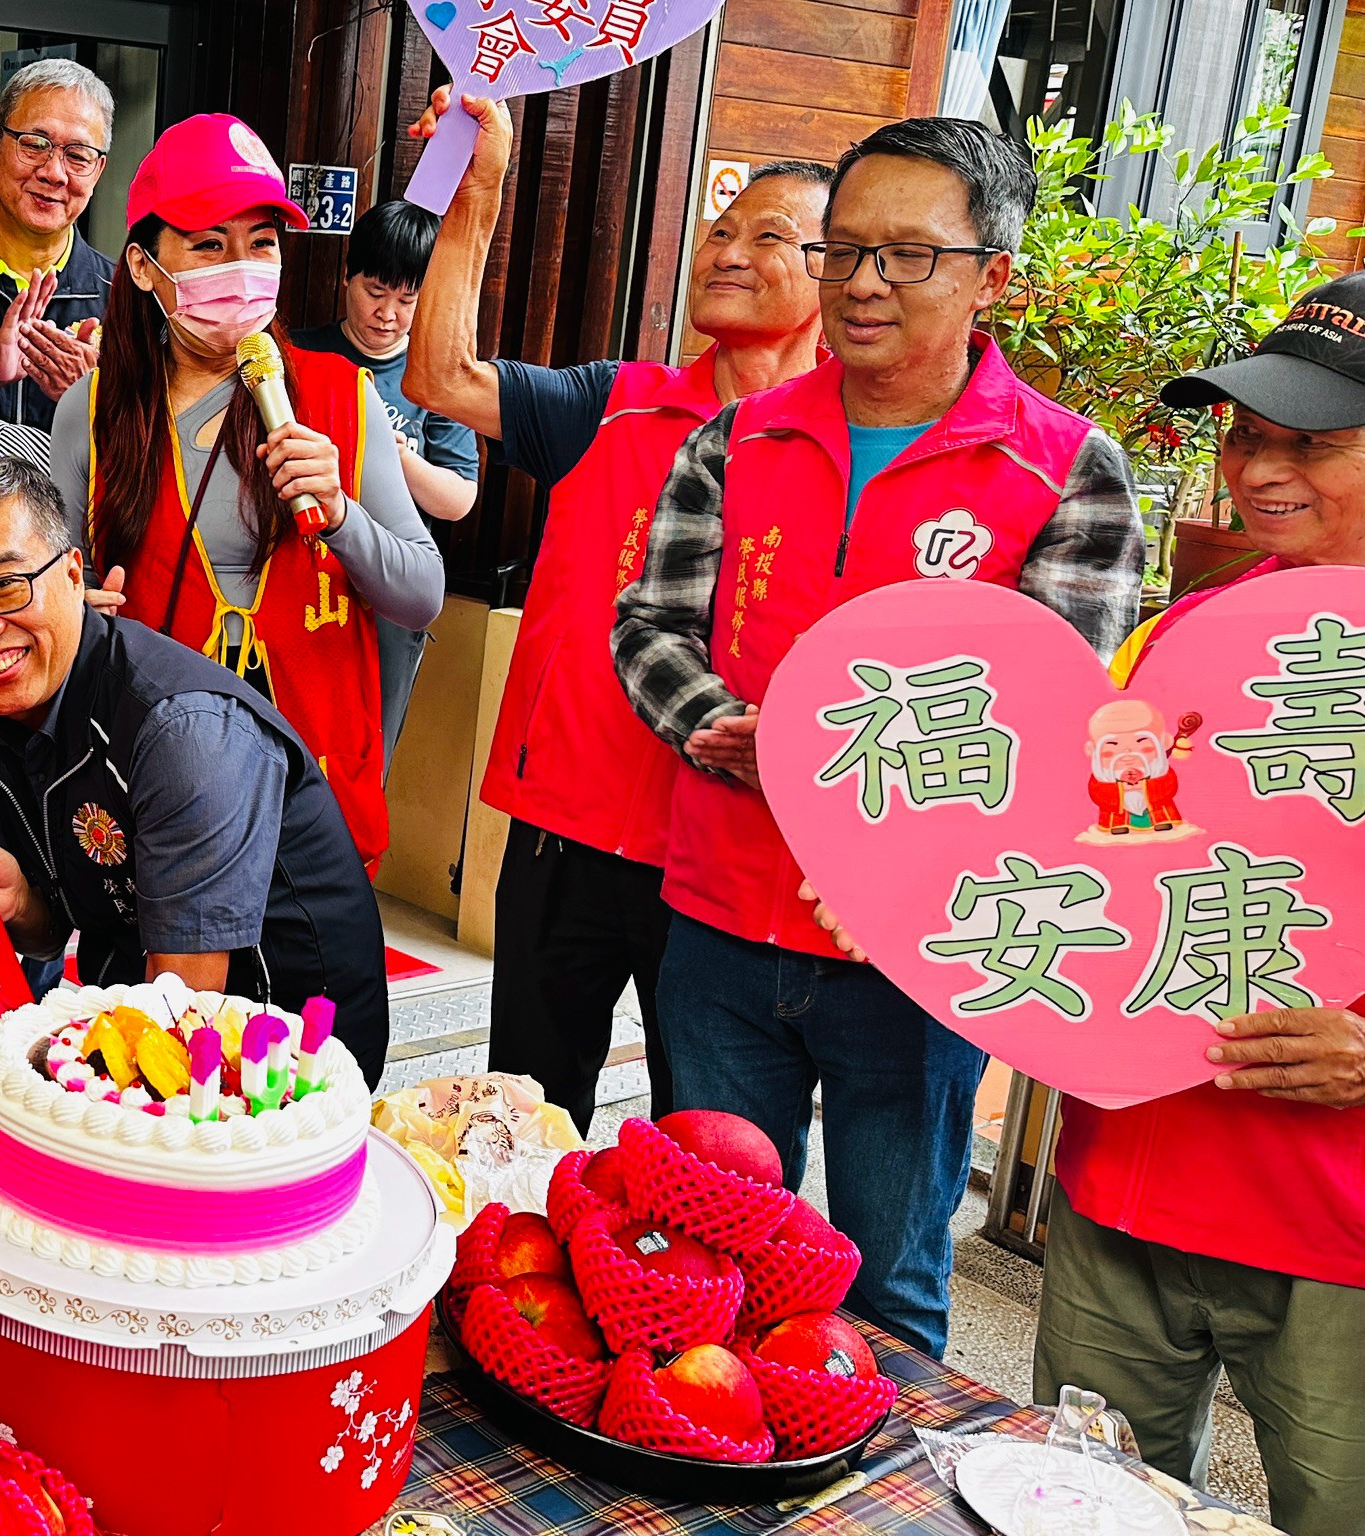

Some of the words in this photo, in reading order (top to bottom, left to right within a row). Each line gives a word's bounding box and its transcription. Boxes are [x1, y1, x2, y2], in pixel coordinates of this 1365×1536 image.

[468, 9, 537, 84] 會
[1308, 325, 1324, 334] OF
[1320, 328, 1343, 344] ASIA
[751, 525, 783, 602] 南投縣
[820, 661, 1012, 819] 福
[919, 846, 1328, 1020] 安康
